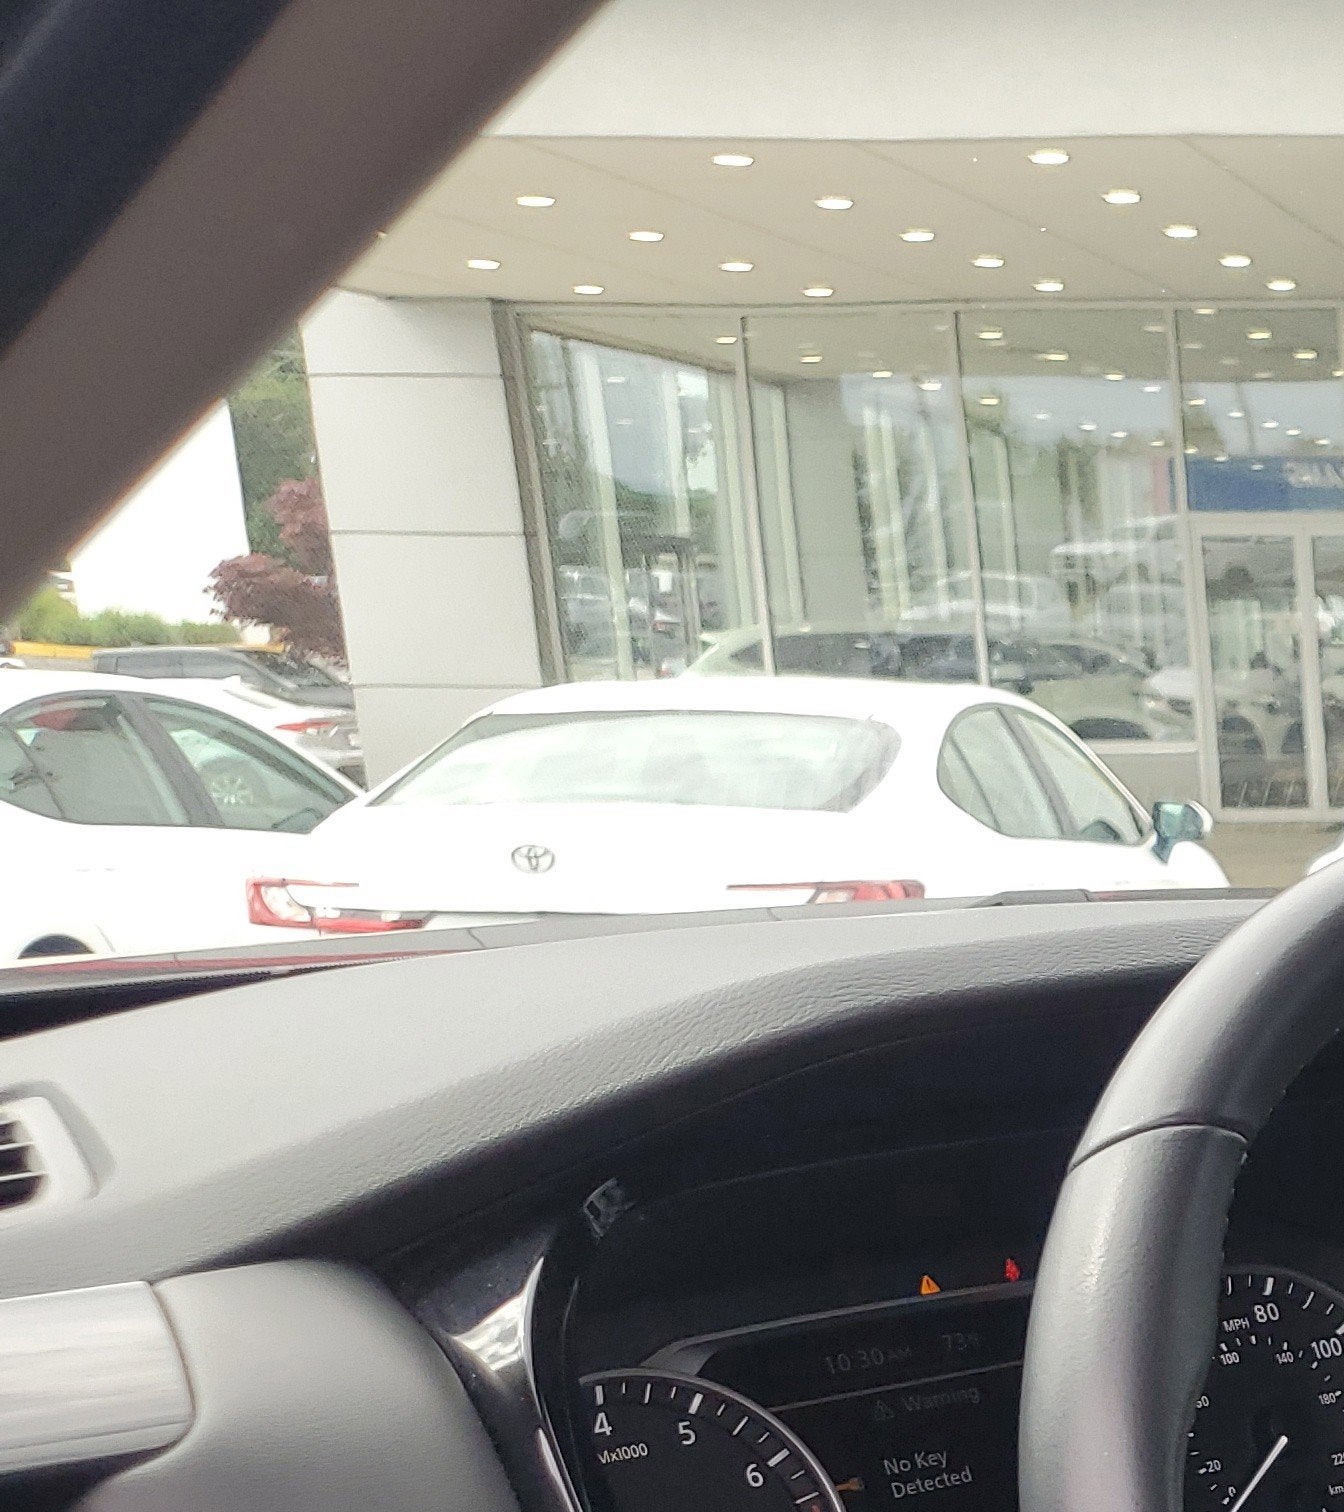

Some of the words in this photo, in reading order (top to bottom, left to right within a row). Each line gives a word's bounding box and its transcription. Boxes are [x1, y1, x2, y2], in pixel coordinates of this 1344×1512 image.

[1222, 1316, 1250, 1333] MPH
[1253, 1302, 1280, 1324] 80
[1219, 1351, 1240, 1366] 100
[1276, 1351, 1294, 1365] 140
[1310, 1337, 1343, 1361] 100
[902, 1387, 981, 1412] Warning
[594, 1412, 613, 1436] 4
[677, 1420, 697, 1445] 5
[883, 1457, 911, 1476] No
[914, 1450, 948, 1469] Key
[1205, 1459, 1221, 1473] 20
[745, 1463, 764, 1488] 6
[890, 1465, 973, 1499] Detected
